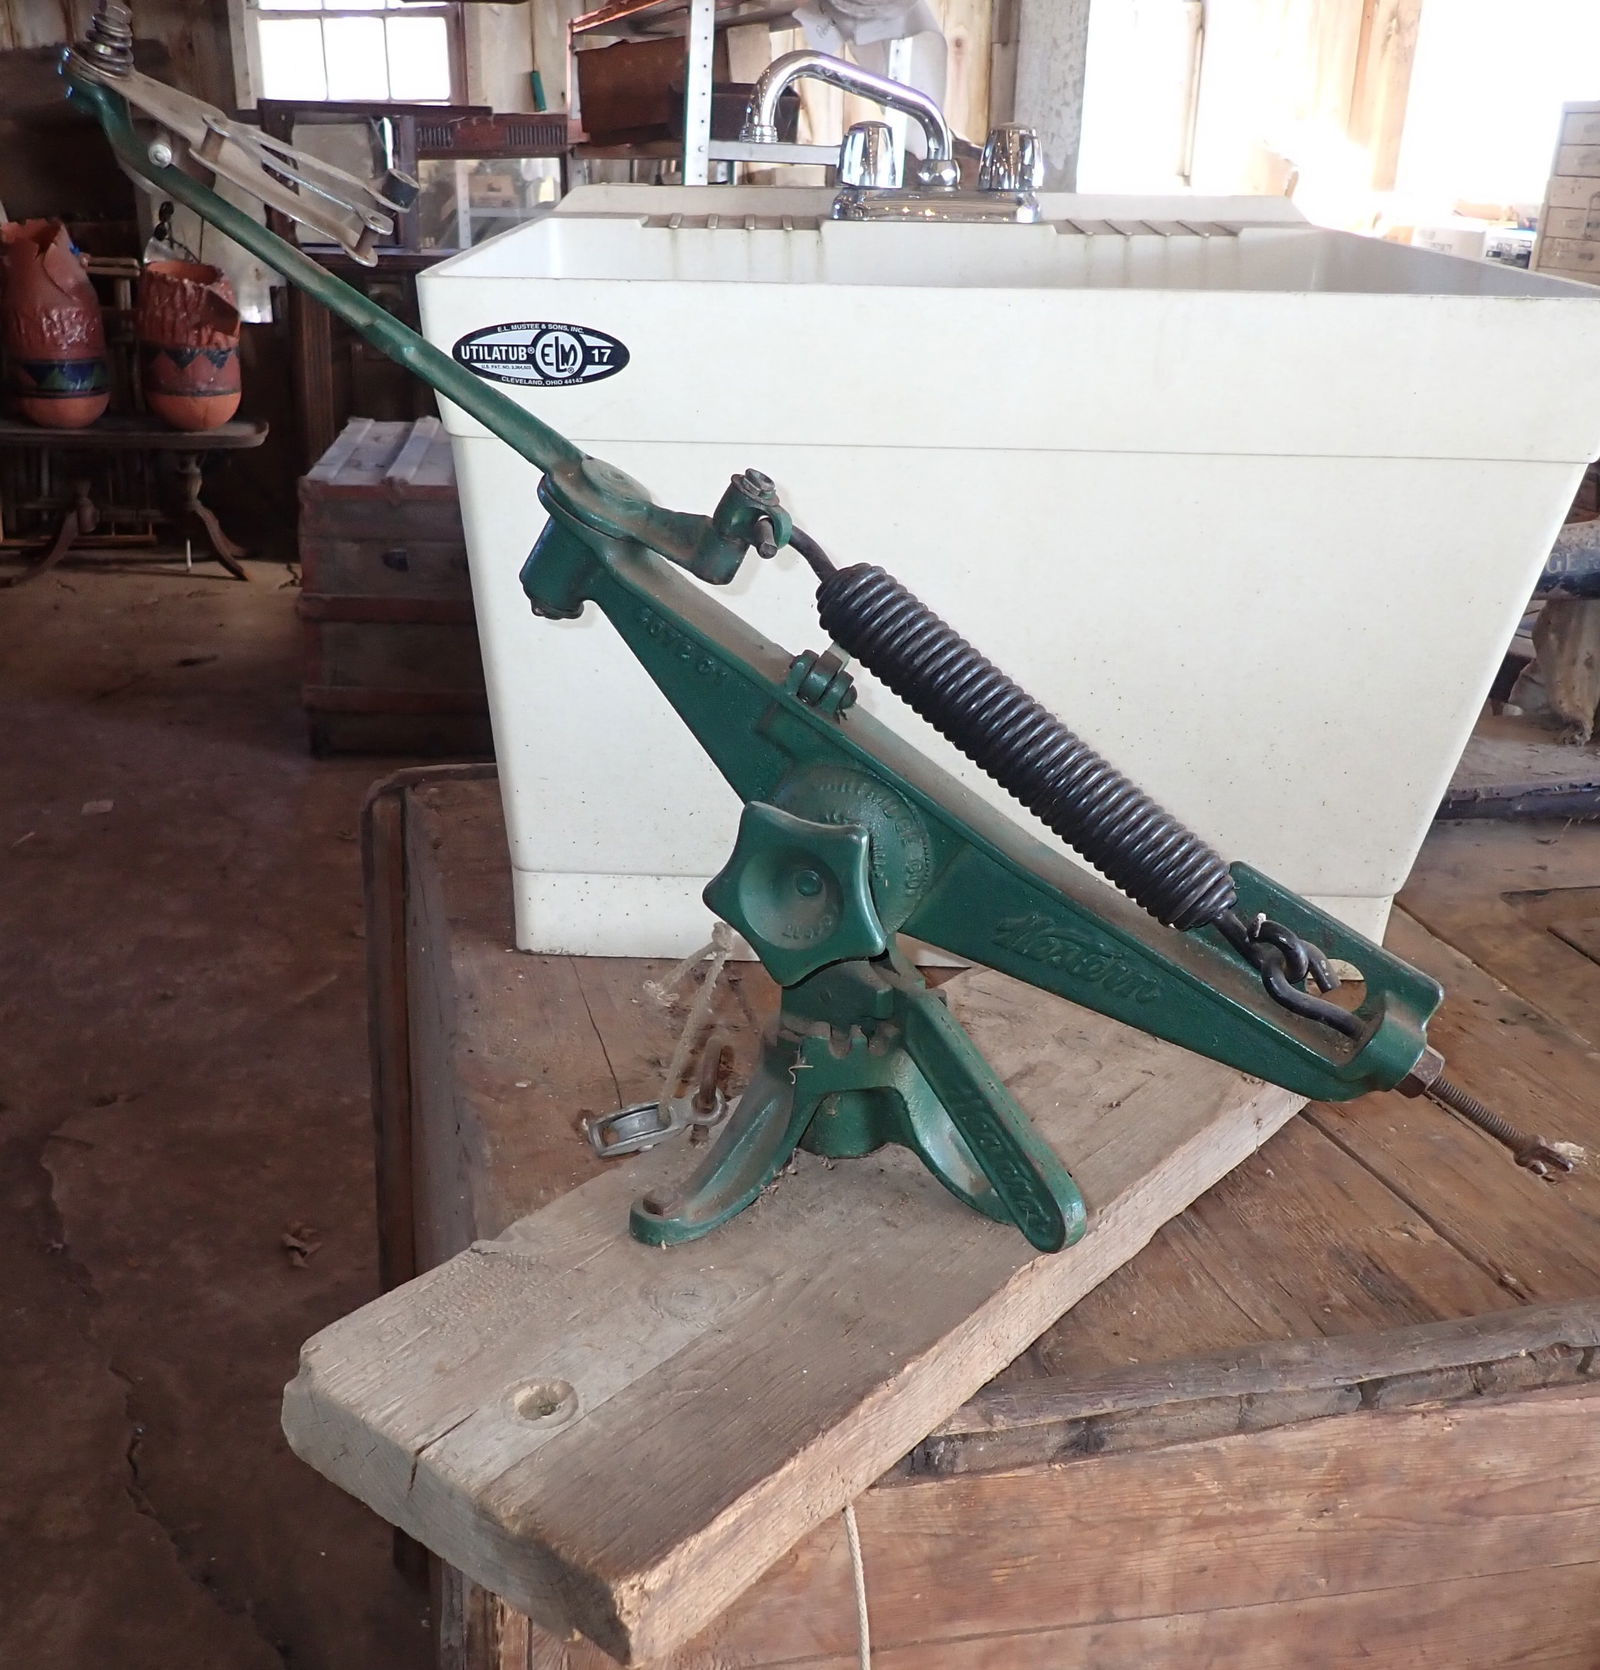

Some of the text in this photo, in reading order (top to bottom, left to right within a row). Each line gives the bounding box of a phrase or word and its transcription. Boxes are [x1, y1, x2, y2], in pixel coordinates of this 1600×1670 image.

[497, 325, 510, 333] E.L.
[511, 323, 540, 331] MUSTEE
[570, 326, 585, 334] INC.
[541, 335, 578, 373] ELM
[591, 348, 612, 363] 17
[501, 376, 545, 386] CLEVELAND,
